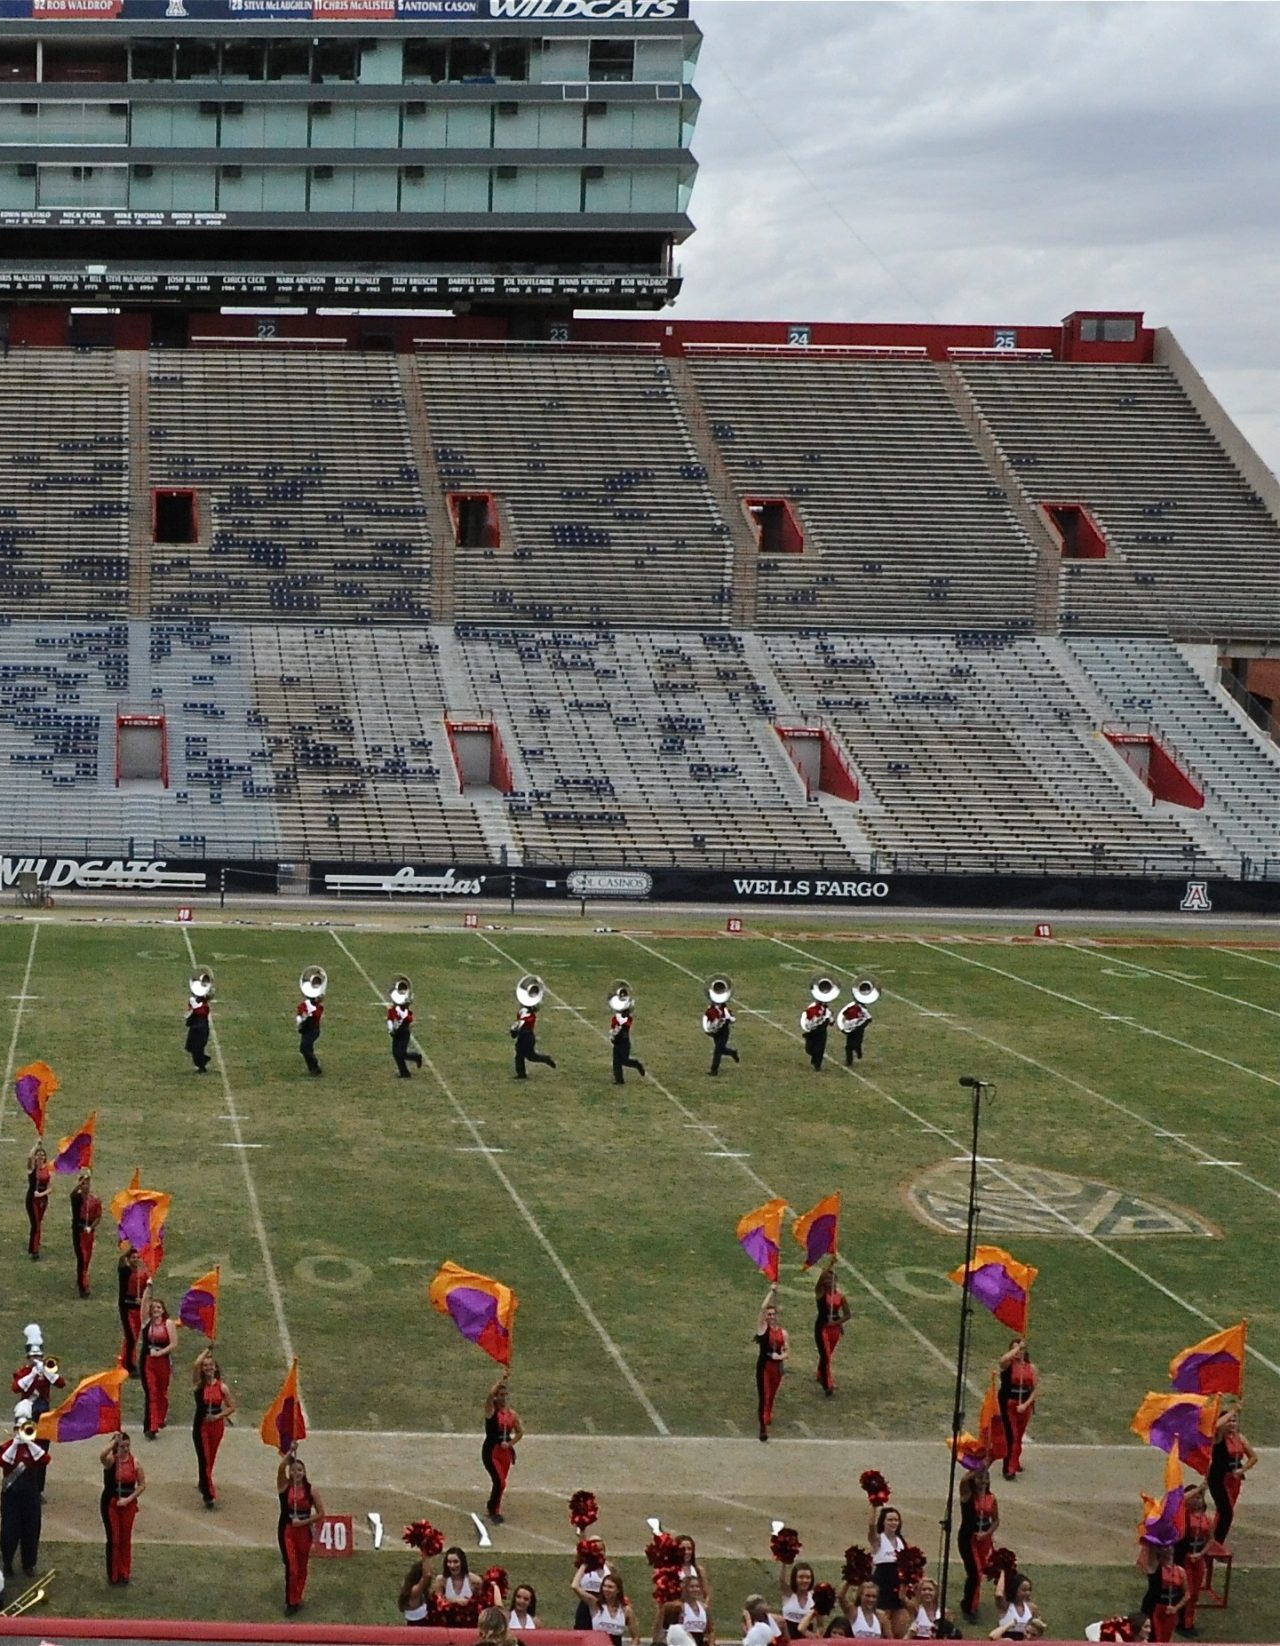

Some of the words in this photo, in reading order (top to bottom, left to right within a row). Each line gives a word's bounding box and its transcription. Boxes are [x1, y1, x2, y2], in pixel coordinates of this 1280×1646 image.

[47, 0, 66, 10] ROB
[68, 0, 113, 10] WALDROP
[232, 0, 243, 10] 28
[243, 0, 264, 10] STEVE
[265, 0, 312, 10] McLAUGHLIN
[314, 0, 322, 10] 11
[322, 0, 346, 10] CHRIS
[348, 0, 394, 11] McALISTER
[397, 0, 404, 11] 5
[404, 1, 443, 11] ANTOINE
[444, 1, 476, 12] CASON
[489, 0, 678, 18] WILDCATS
[257, 325, 276, 338] 22
[550, 328, 568, 341] 23
[790, 332, 808, 346] 24
[996, 336, 1015, 349] 25
[576, 876, 595, 889] SOL
[597, 877, 644, 889] CASINOS
[733, 879, 810, 895] WELLS
[815, 881, 889, 897] FARGO
[319, 1522, 347, 1550] 40
